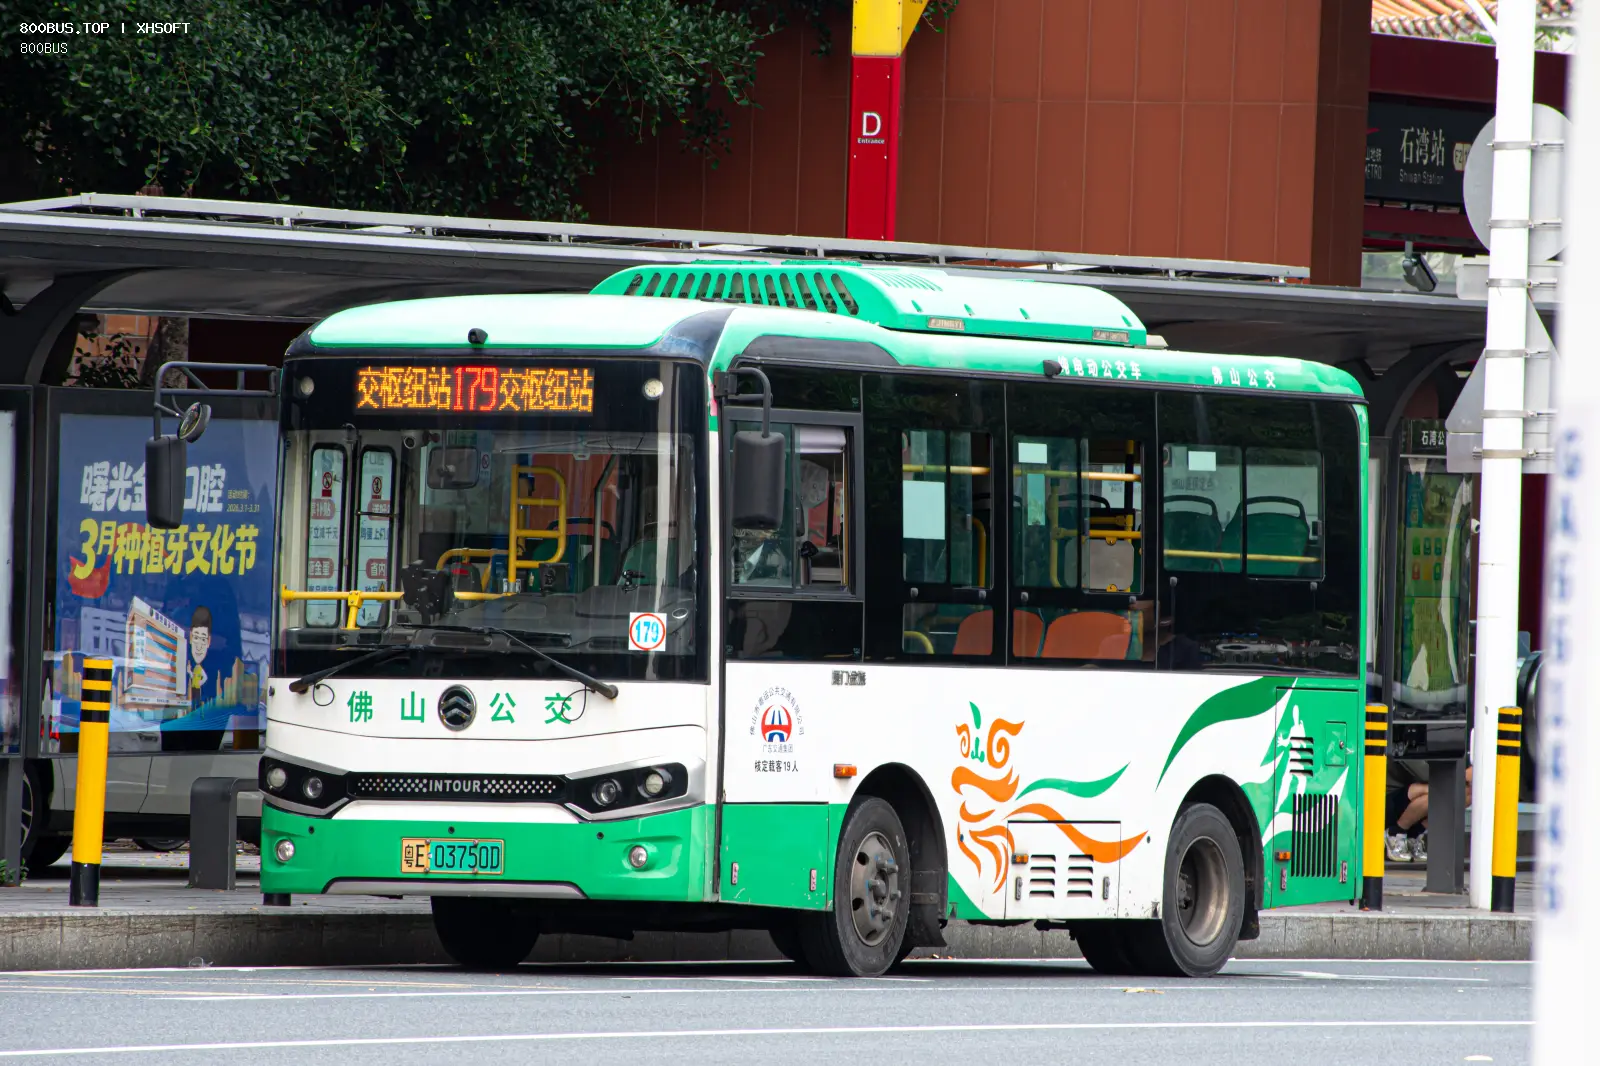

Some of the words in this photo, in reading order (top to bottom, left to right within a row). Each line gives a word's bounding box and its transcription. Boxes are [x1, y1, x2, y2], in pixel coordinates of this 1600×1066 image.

[862, 111, 881, 136] D
[857, 137, 885, 145] Entrance
[1399, 126, 1446, 168] 石湾站
[1364, 163, 1382, 180] ETRO
[357, 366, 452, 409] 交枢纽站
[453, 365, 498, 412] 179
[499, 368, 594, 412] 交枢纽站
[1211, 366, 1276, 389] 佛山公交
[80, 460, 226, 513] 曙光金口腔
[74, 518, 259, 580] 3月种植牙文化节
[635, 620, 660, 643] 179
[346, 690, 572, 725] 佛山公交
[428, 779, 481, 793] INTOUR
[404, 844, 425, 868] 粤E
[434, 844, 501, 869] 03750D
